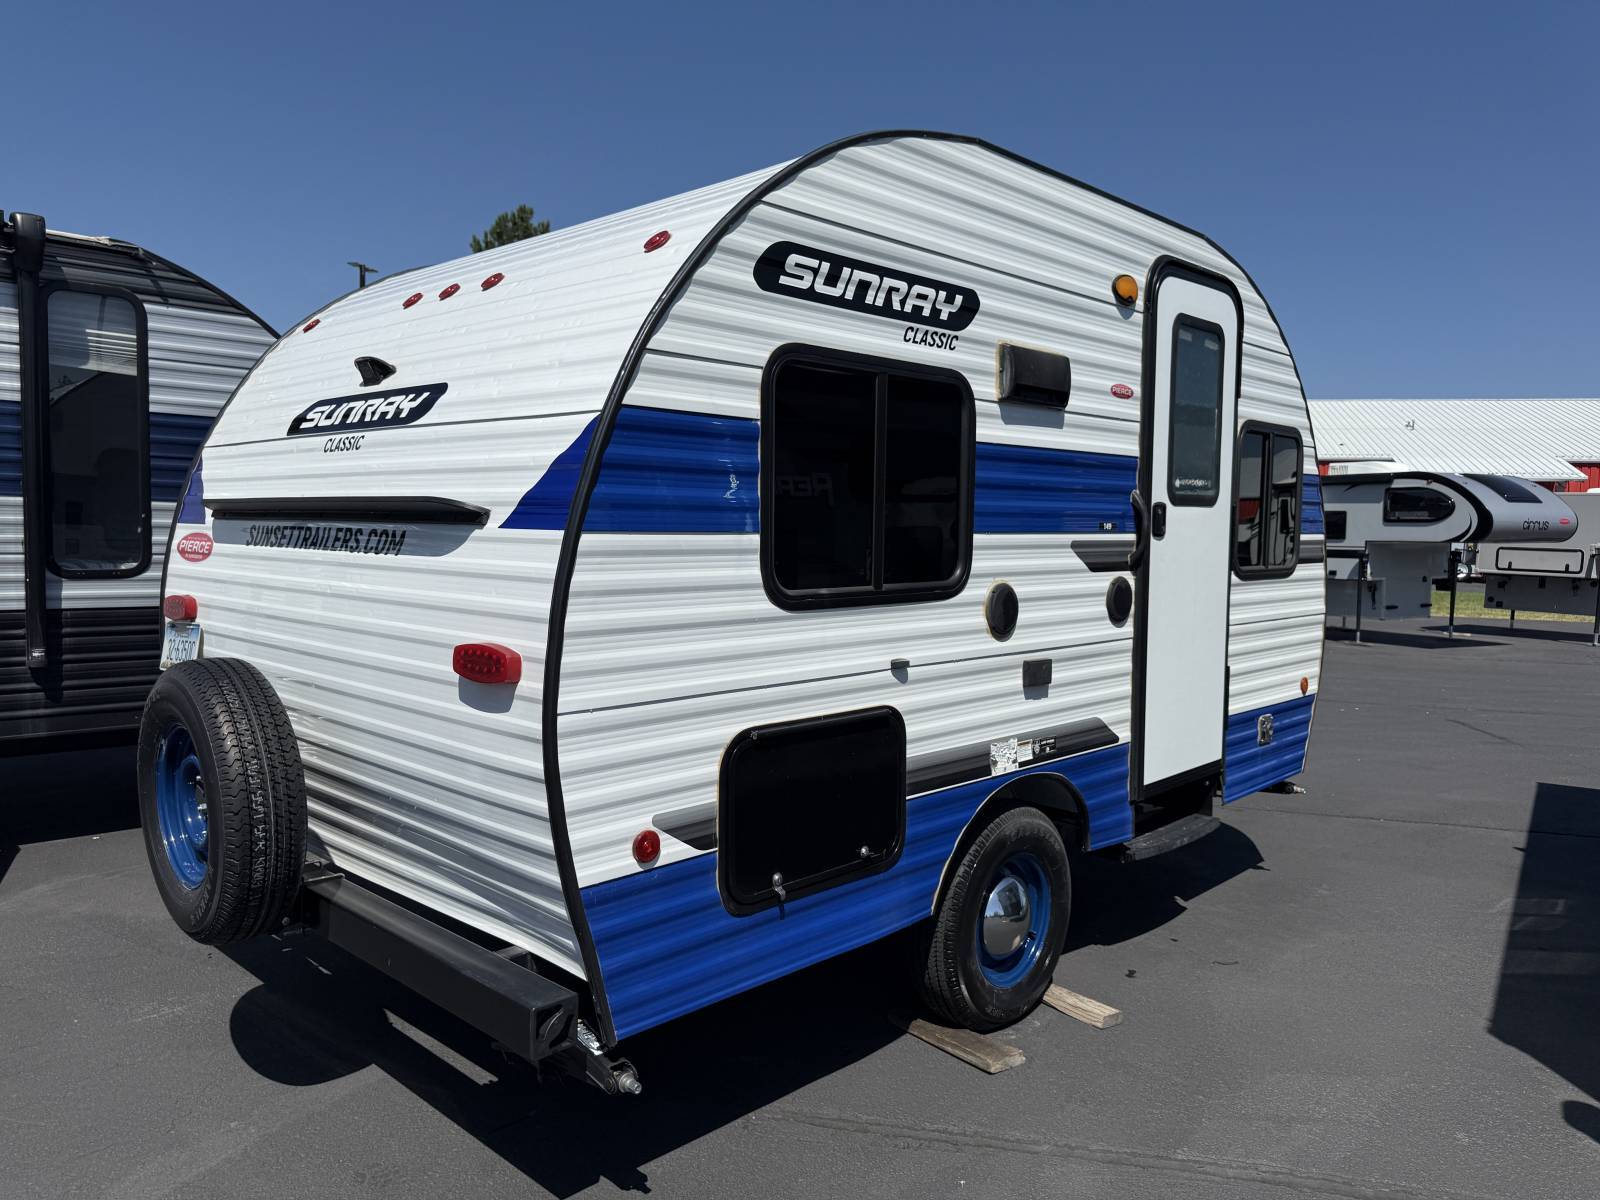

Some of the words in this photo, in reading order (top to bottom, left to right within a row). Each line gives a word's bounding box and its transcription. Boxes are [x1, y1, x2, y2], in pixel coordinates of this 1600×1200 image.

[778, 253, 963, 321] SUNRAY
[903, 326, 960, 350] CLASSIC
[1112, 385, 1132, 396] PIERCE
[299, 392, 431, 429] SUNRAY
[323, 435, 366, 453] CLASSIC
[1522, 518, 1550, 531] cirrus
[179, 540, 212, 553] PIERCE
[246, 525, 407, 556] SUNSETTRAILERS.COM
